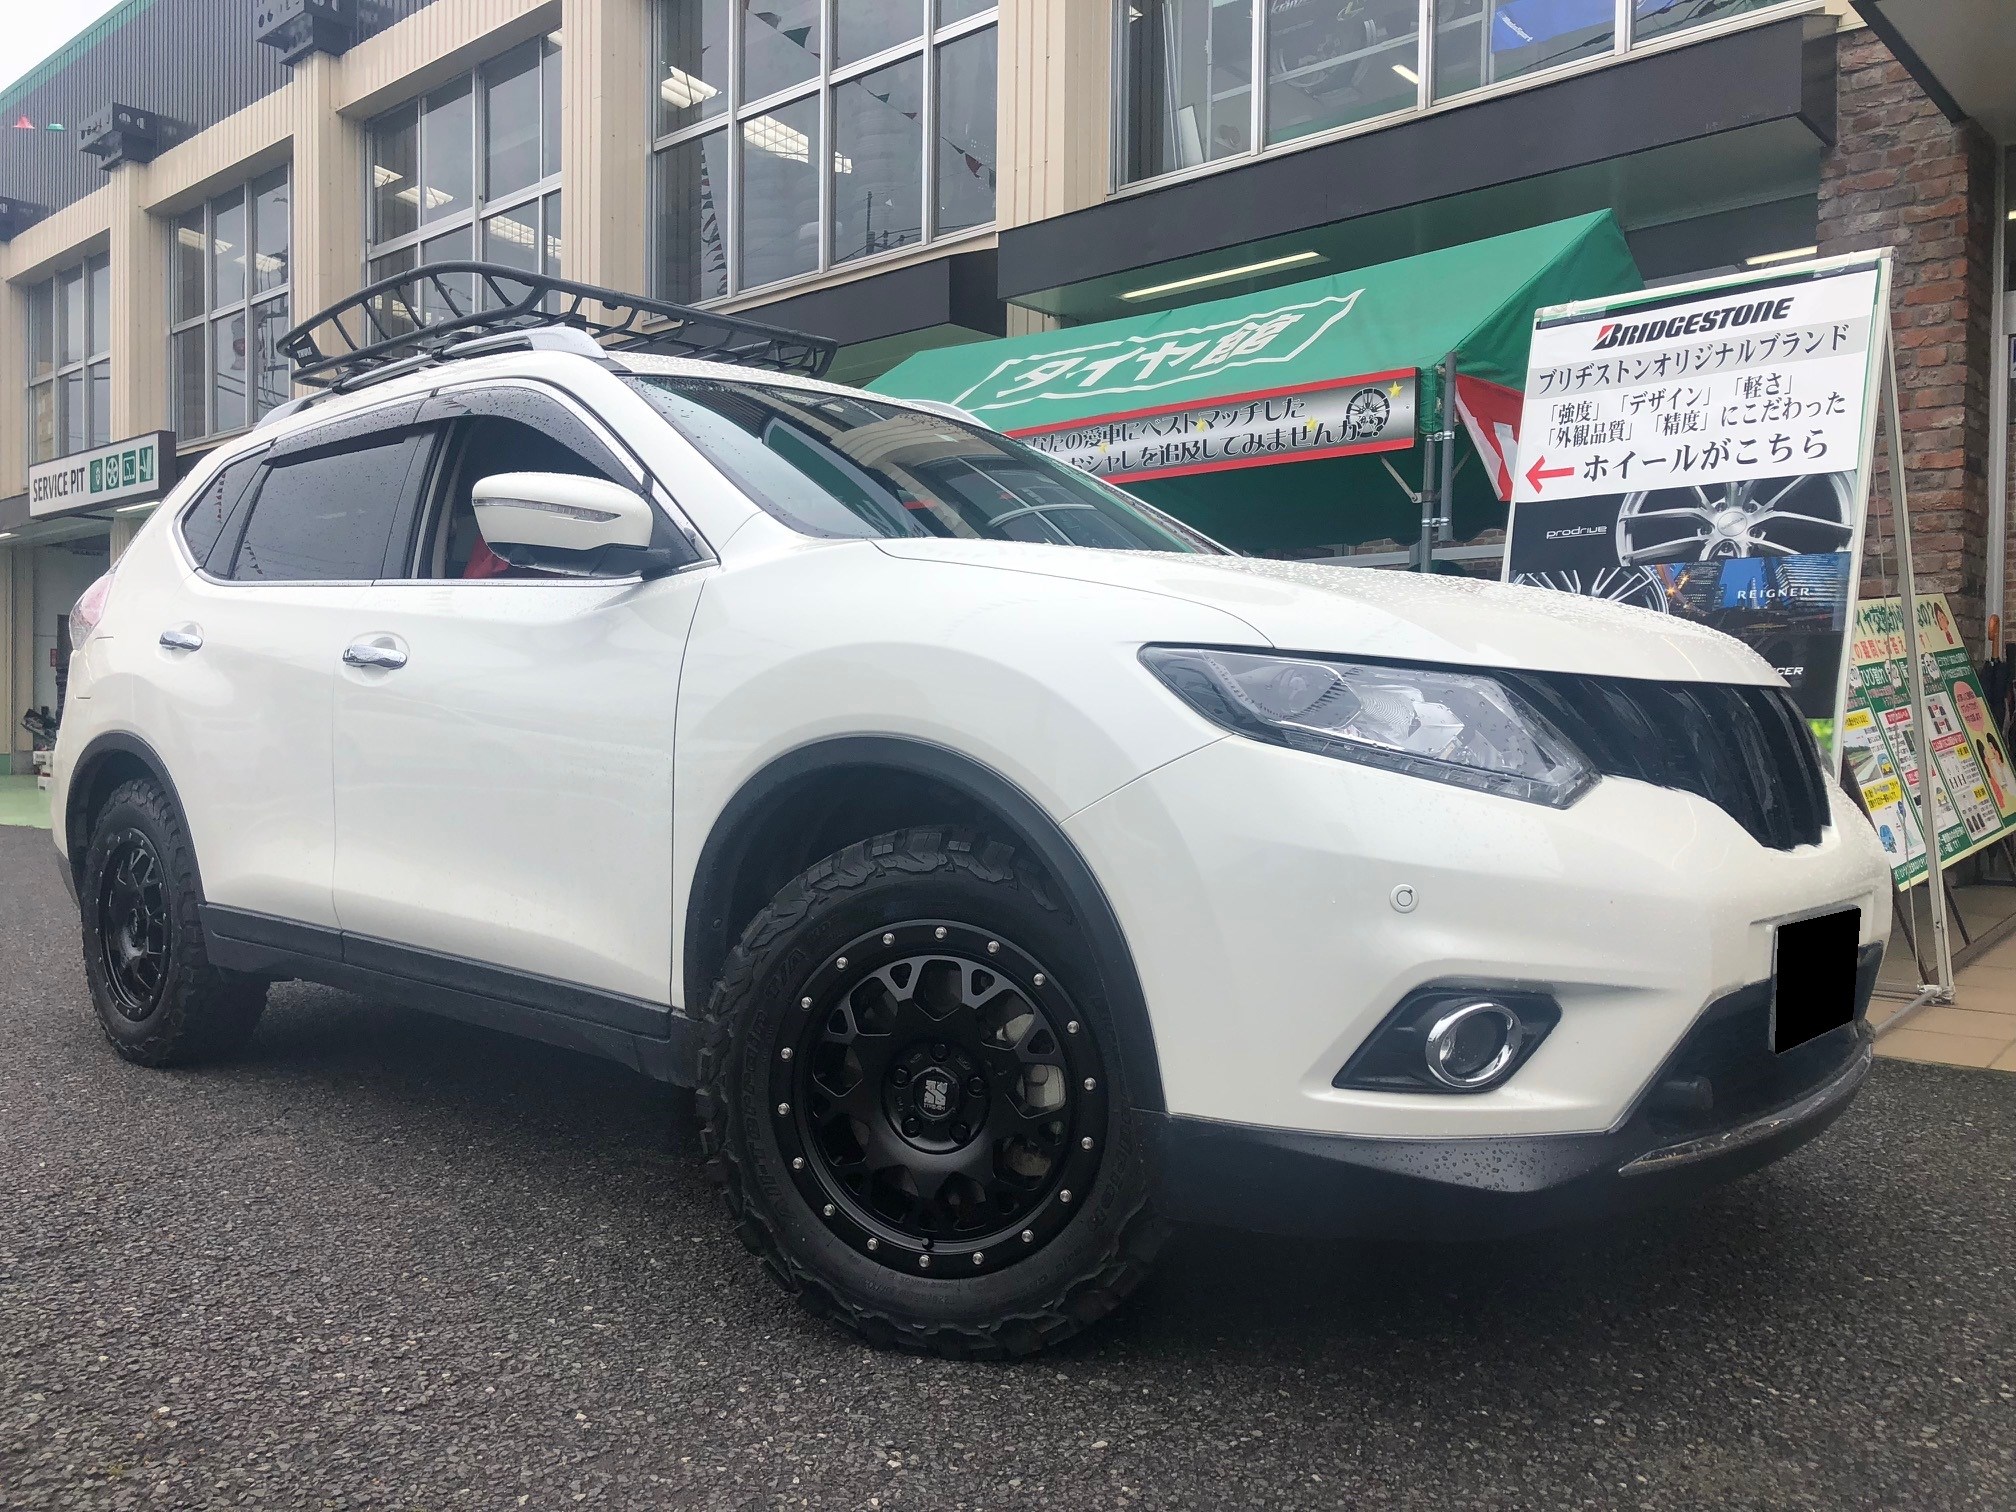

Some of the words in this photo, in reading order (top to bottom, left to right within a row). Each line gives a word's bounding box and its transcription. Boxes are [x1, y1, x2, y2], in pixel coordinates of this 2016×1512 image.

[1591, 297, 1795, 351] BRIDGESTONE
[996, 314, 1306, 398] タイヤ館
[1539, 324, 1850, 394] ブリヂストンオリジナルブランド
[1018, 397, 1306, 454] なたの愛車にベストマッチした
[1583, 429, 1828, 482] ホイールがこちら
[33, 471, 69, 503] SERVICE
[70, 467, 86, 493] PIT
[1546, 525, 1608, 540] prodrive
[1738, 587, 1810, 600] REIGNER
[1775, 667, 1804, 676] CER
